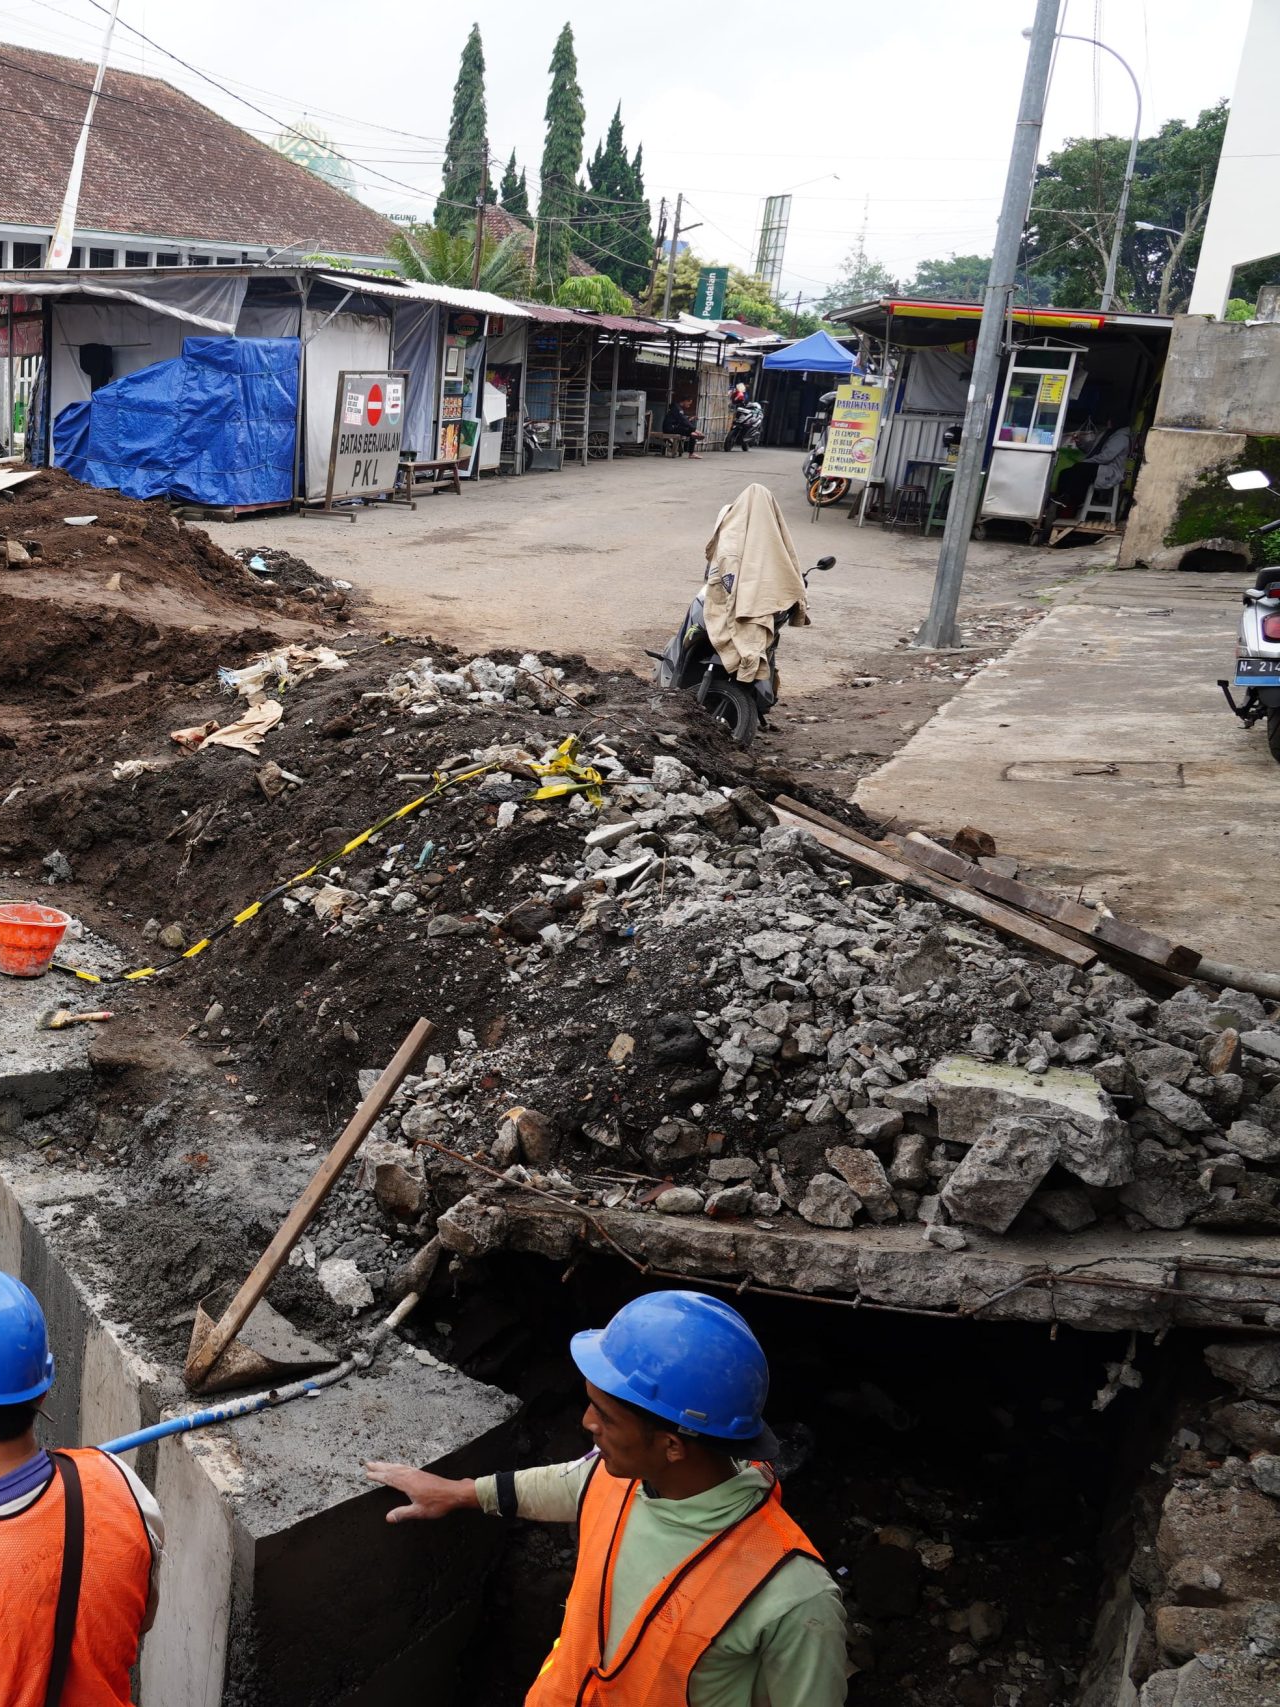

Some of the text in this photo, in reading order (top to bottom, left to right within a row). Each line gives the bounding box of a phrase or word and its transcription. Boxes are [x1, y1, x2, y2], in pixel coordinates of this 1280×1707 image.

[390, 213, 417, 221] AGUNG
[702, 272, 716, 317] Pegadaian
[851, 390, 870, 400] Es
[340, 432, 400, 455] BATAS BERJUALAN
